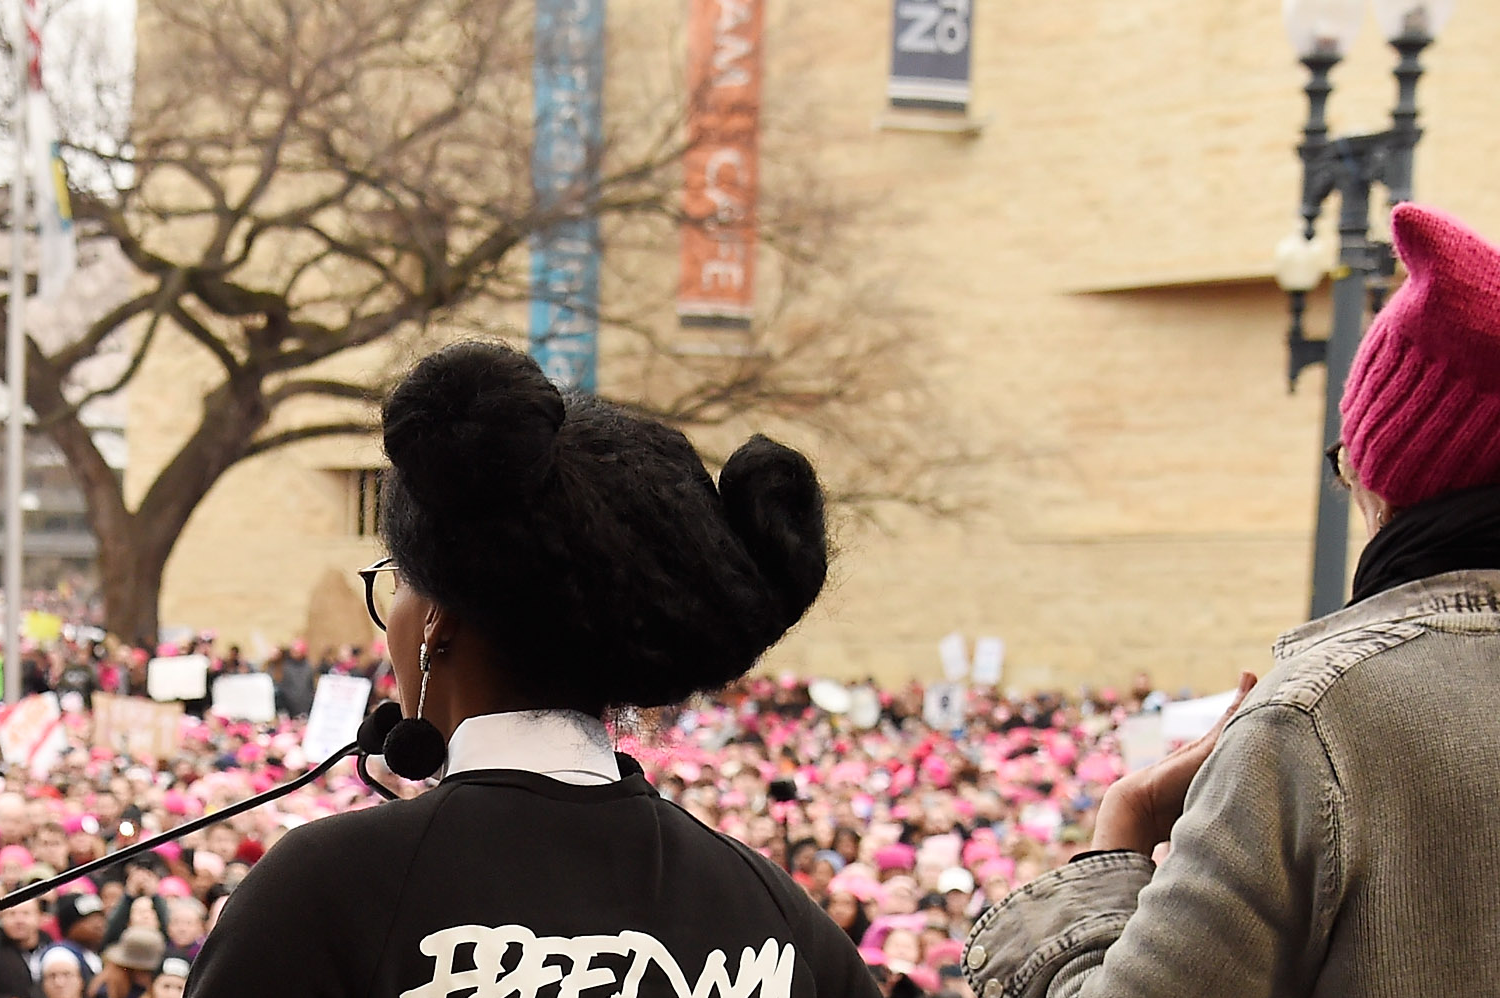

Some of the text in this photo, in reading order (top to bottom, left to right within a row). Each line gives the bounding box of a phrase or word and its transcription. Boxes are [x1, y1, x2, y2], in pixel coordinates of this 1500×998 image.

[895, 0, 940, 53] N
[701, 0, 754, 291] AM CAFE
